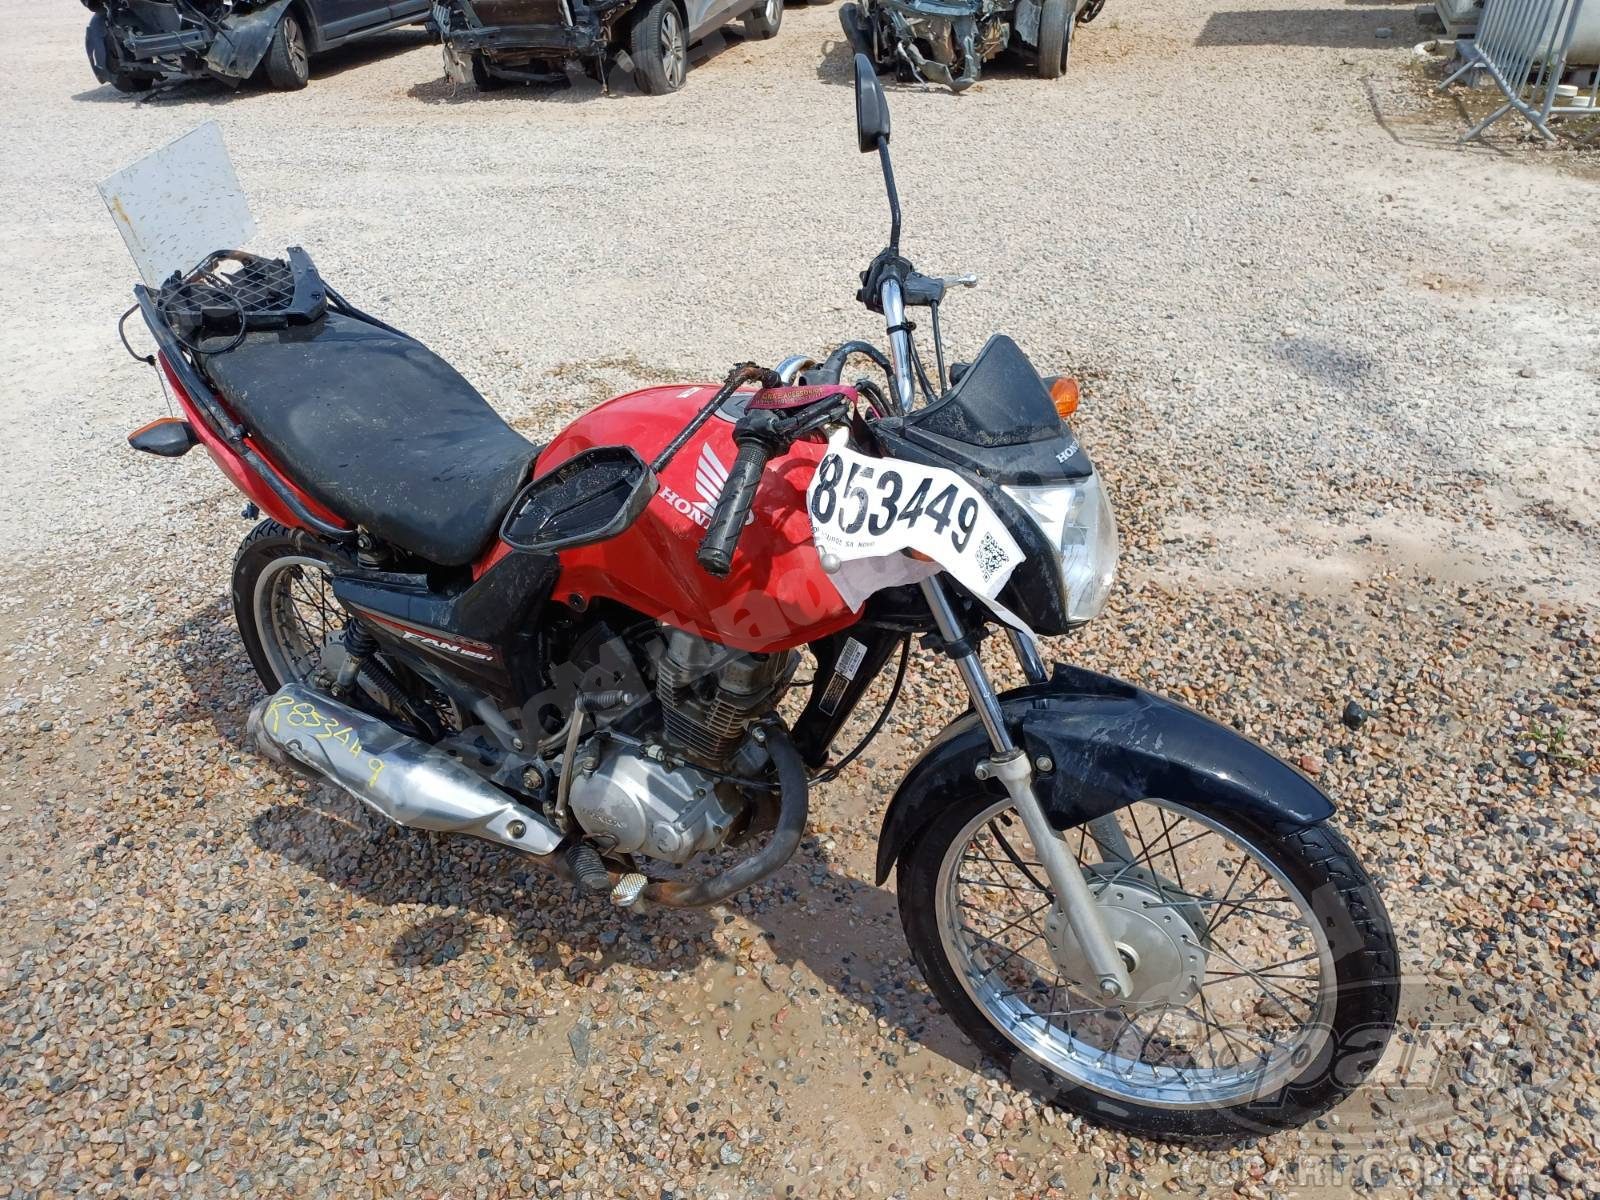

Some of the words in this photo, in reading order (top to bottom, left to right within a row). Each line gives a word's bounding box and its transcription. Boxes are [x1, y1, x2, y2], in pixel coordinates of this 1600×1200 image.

[658, 487, 713, 530] HON
[811, 452, 979, 554] 853449
[402, 630, 461, 652] FAN
